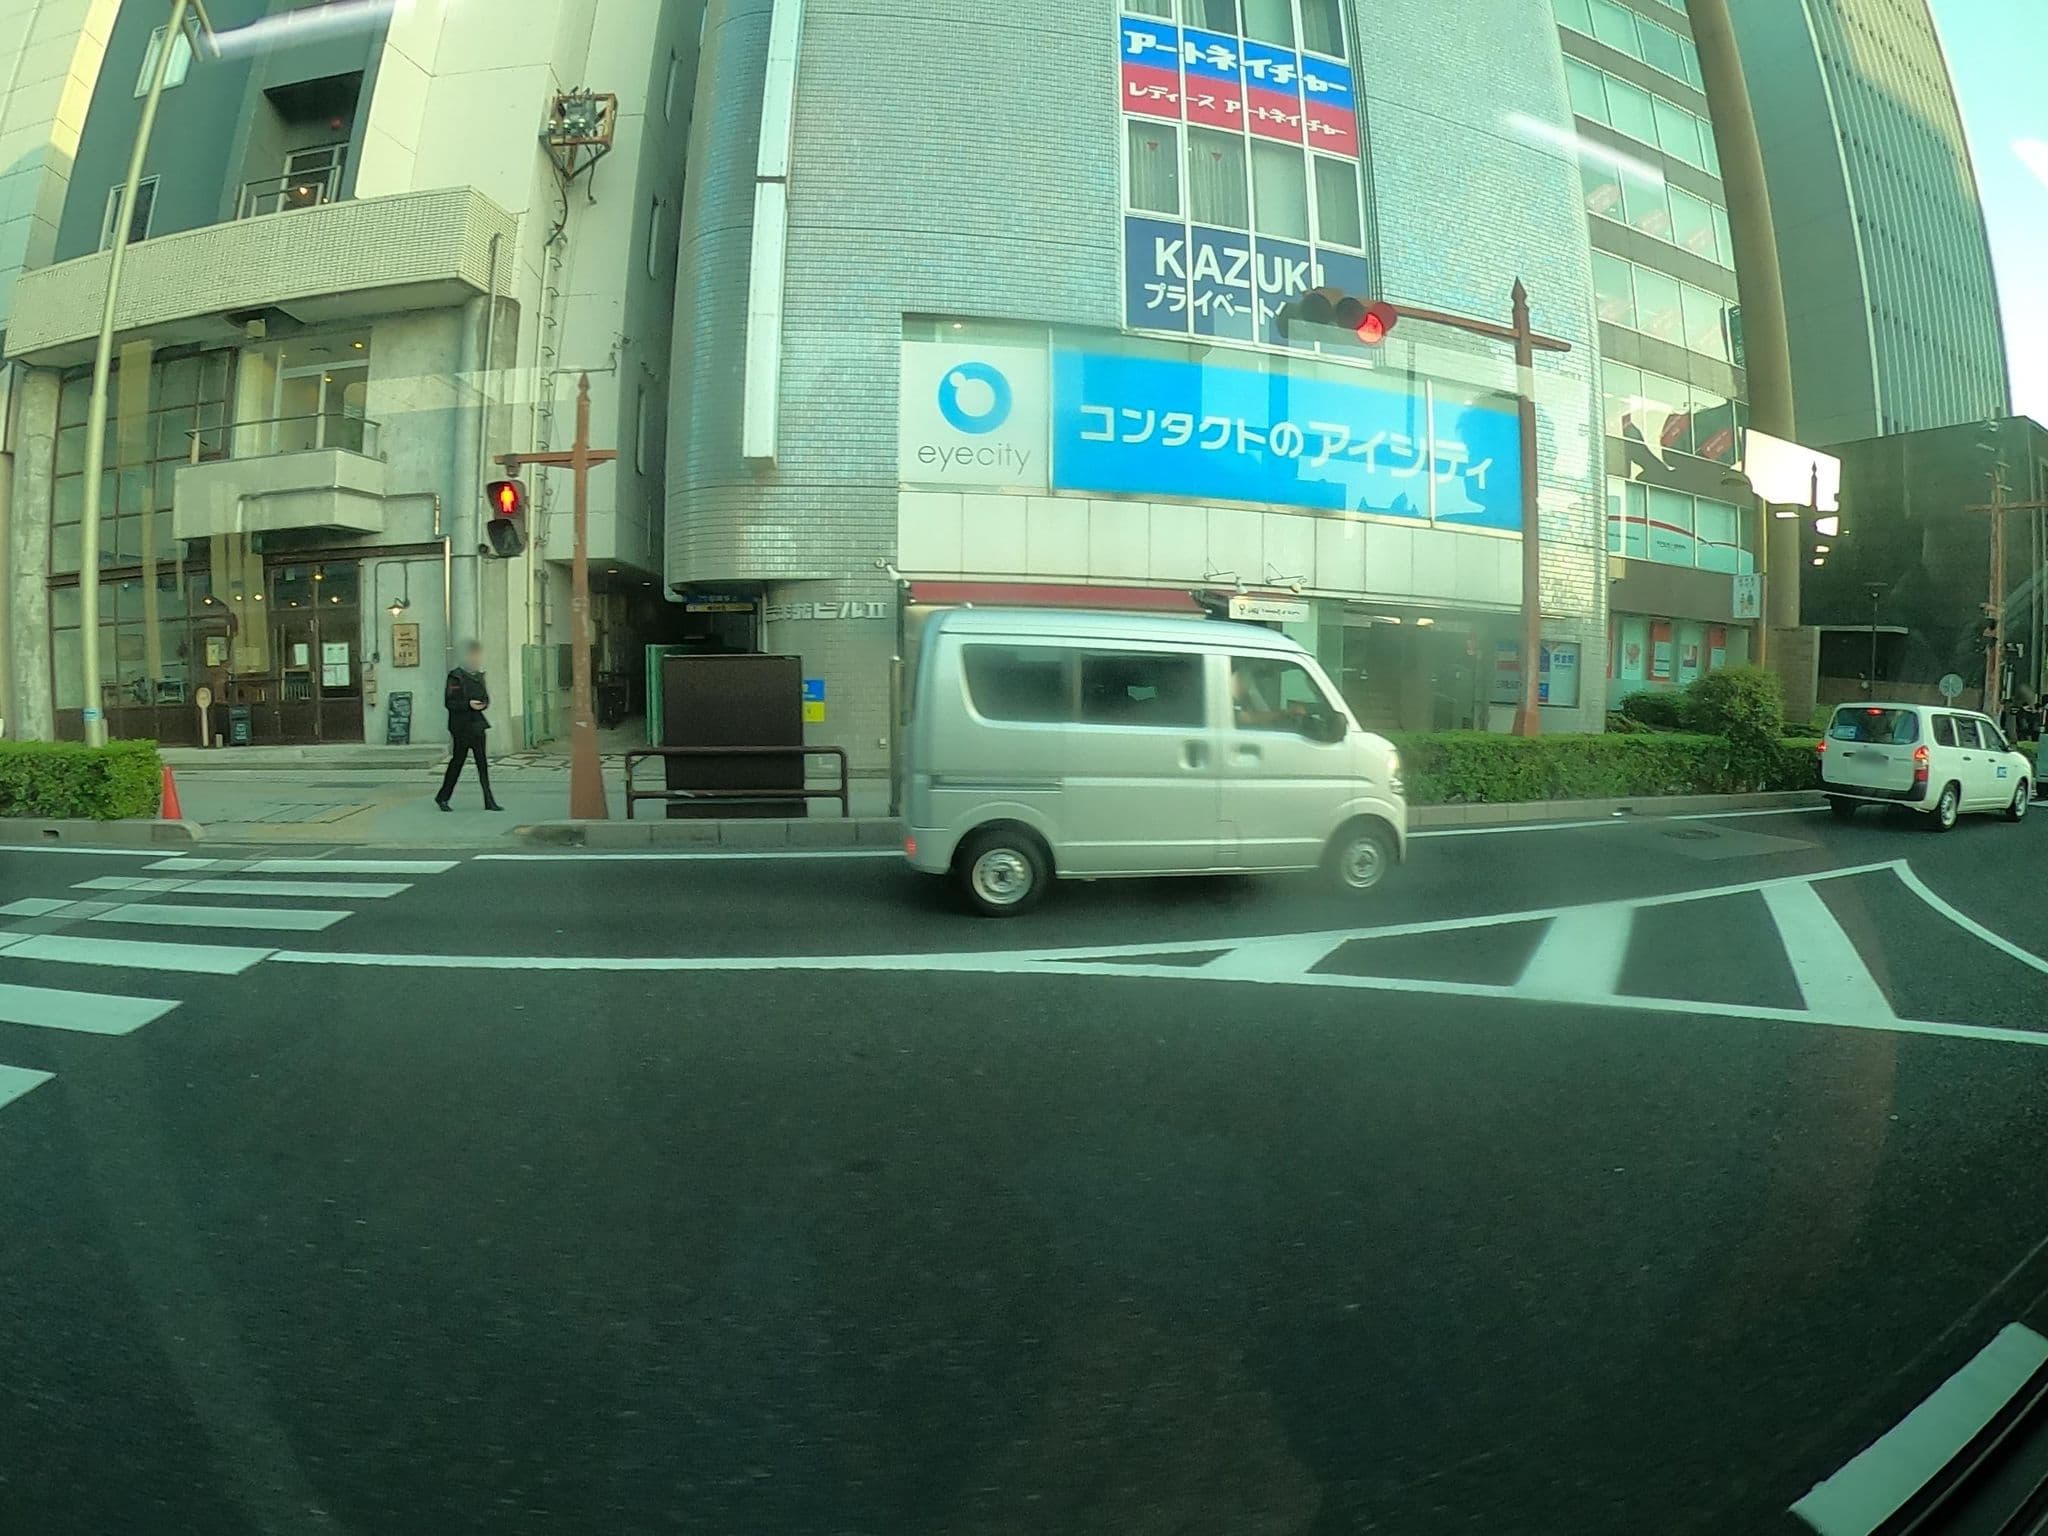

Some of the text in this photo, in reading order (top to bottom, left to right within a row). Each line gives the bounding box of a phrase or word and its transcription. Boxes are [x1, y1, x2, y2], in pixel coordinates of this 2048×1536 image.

[1124, 30, 1347, 92] アートネイチャー
[1128, 82, 1348, 135] レディース アートネイチャー
[1155, 237, 1325, 297] KAZUKI
[1144, 283, 1287, 325] プライベート
[917, 443, 1031, 475] eyecity
[1080, 404, 1494, 490] コンタクトのアイシティ
